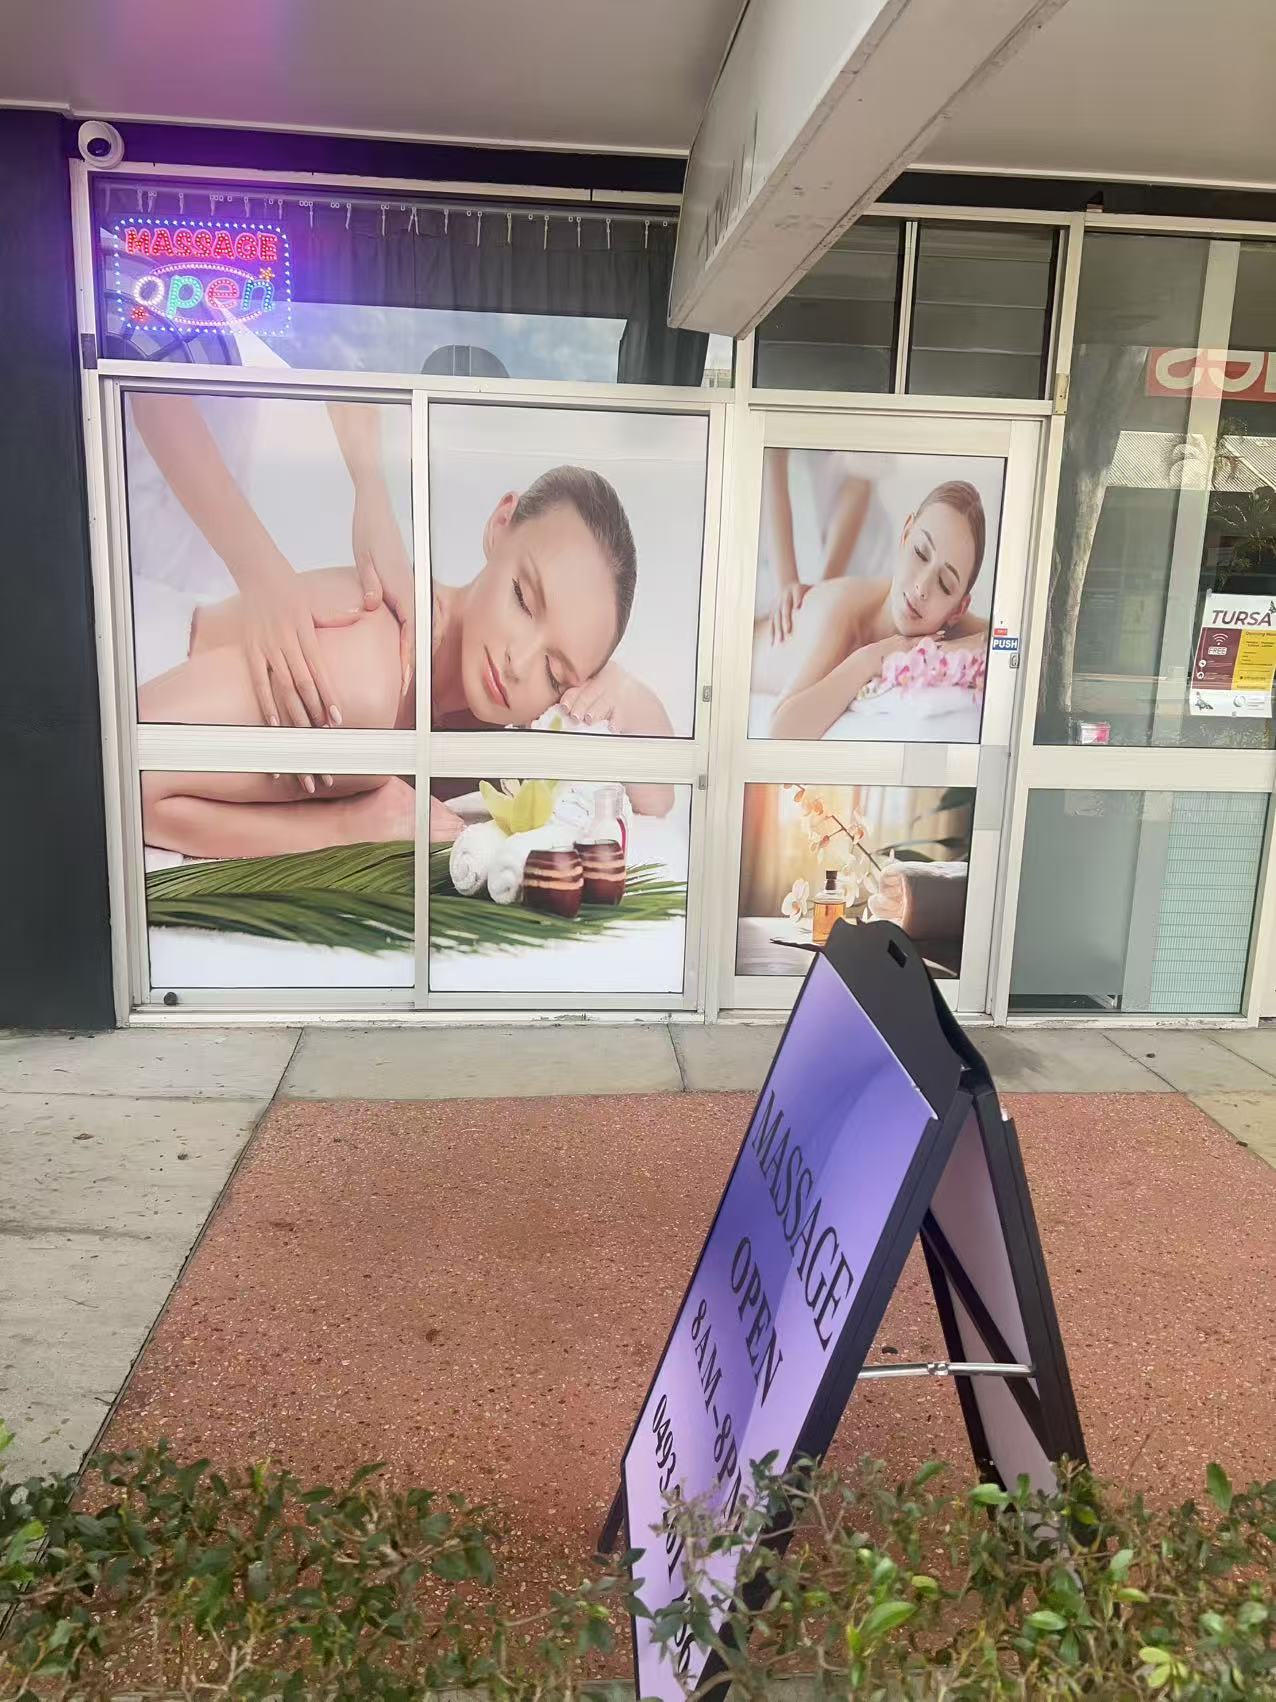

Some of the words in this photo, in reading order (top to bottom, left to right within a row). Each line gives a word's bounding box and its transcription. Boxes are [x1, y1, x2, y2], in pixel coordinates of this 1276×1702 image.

[125, 226, 278, 262] MASSAGE
[133, 274, 276, 319] open
[1212, 609, 1272, 627] TURSA
[993, 639, 1018, 649] PUSH
[752, 1090, 855, 1351] MASSAGE
[731, 1236, 784, 1408] OPEN
[652, 1393, 676, 1494] 0493
